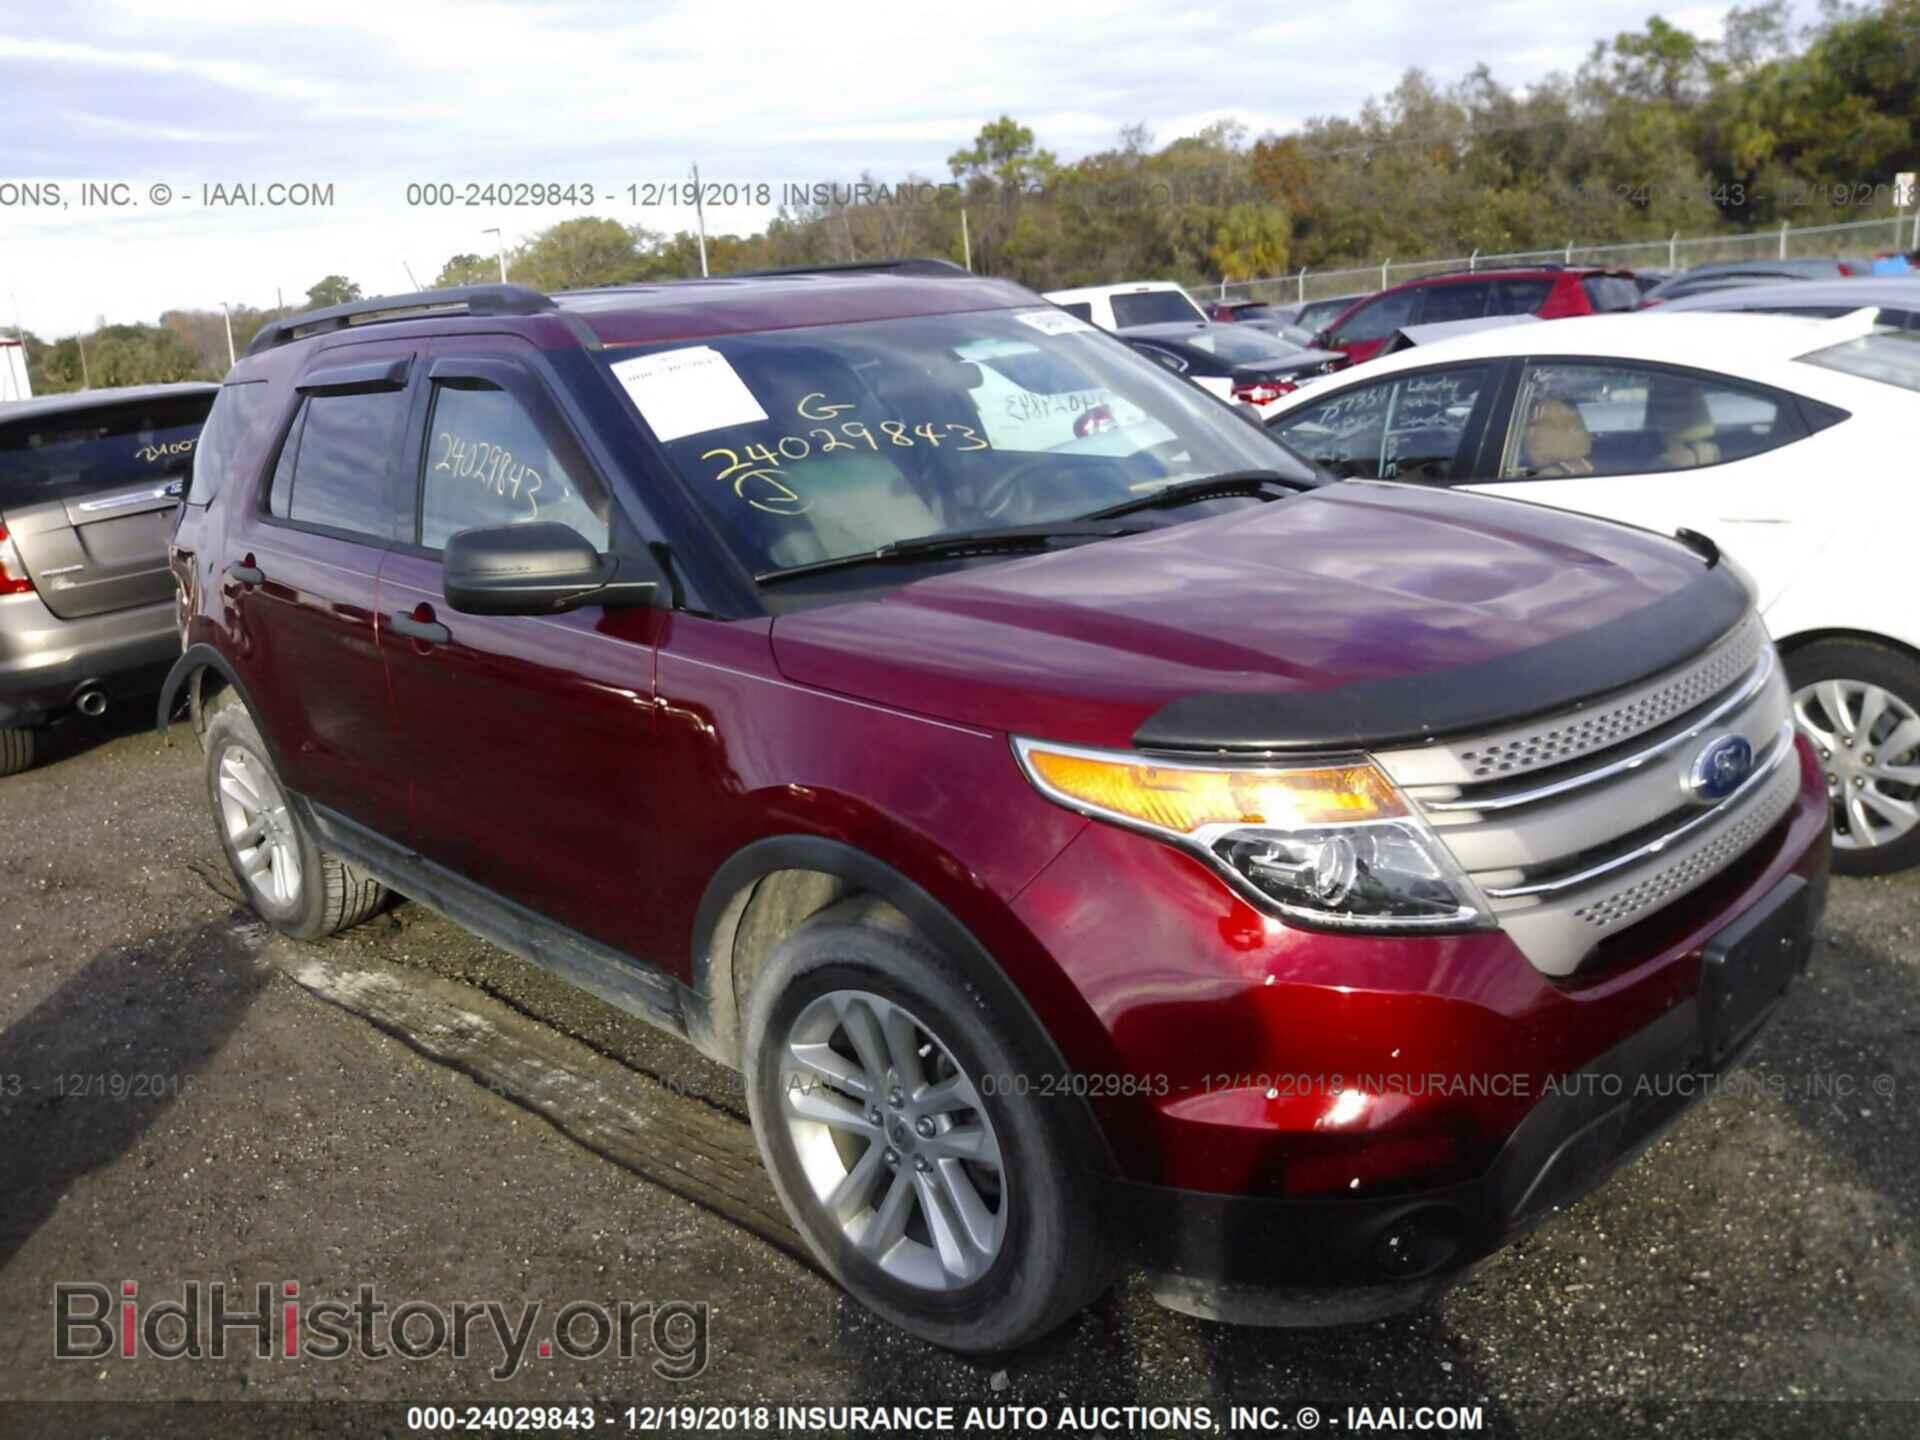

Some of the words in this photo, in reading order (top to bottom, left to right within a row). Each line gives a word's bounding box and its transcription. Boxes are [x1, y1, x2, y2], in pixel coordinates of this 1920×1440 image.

[798, 393, 856, 420] G
[435, 432, 542, 521] 24029843
[702, 425, 992, 480] 24029843
